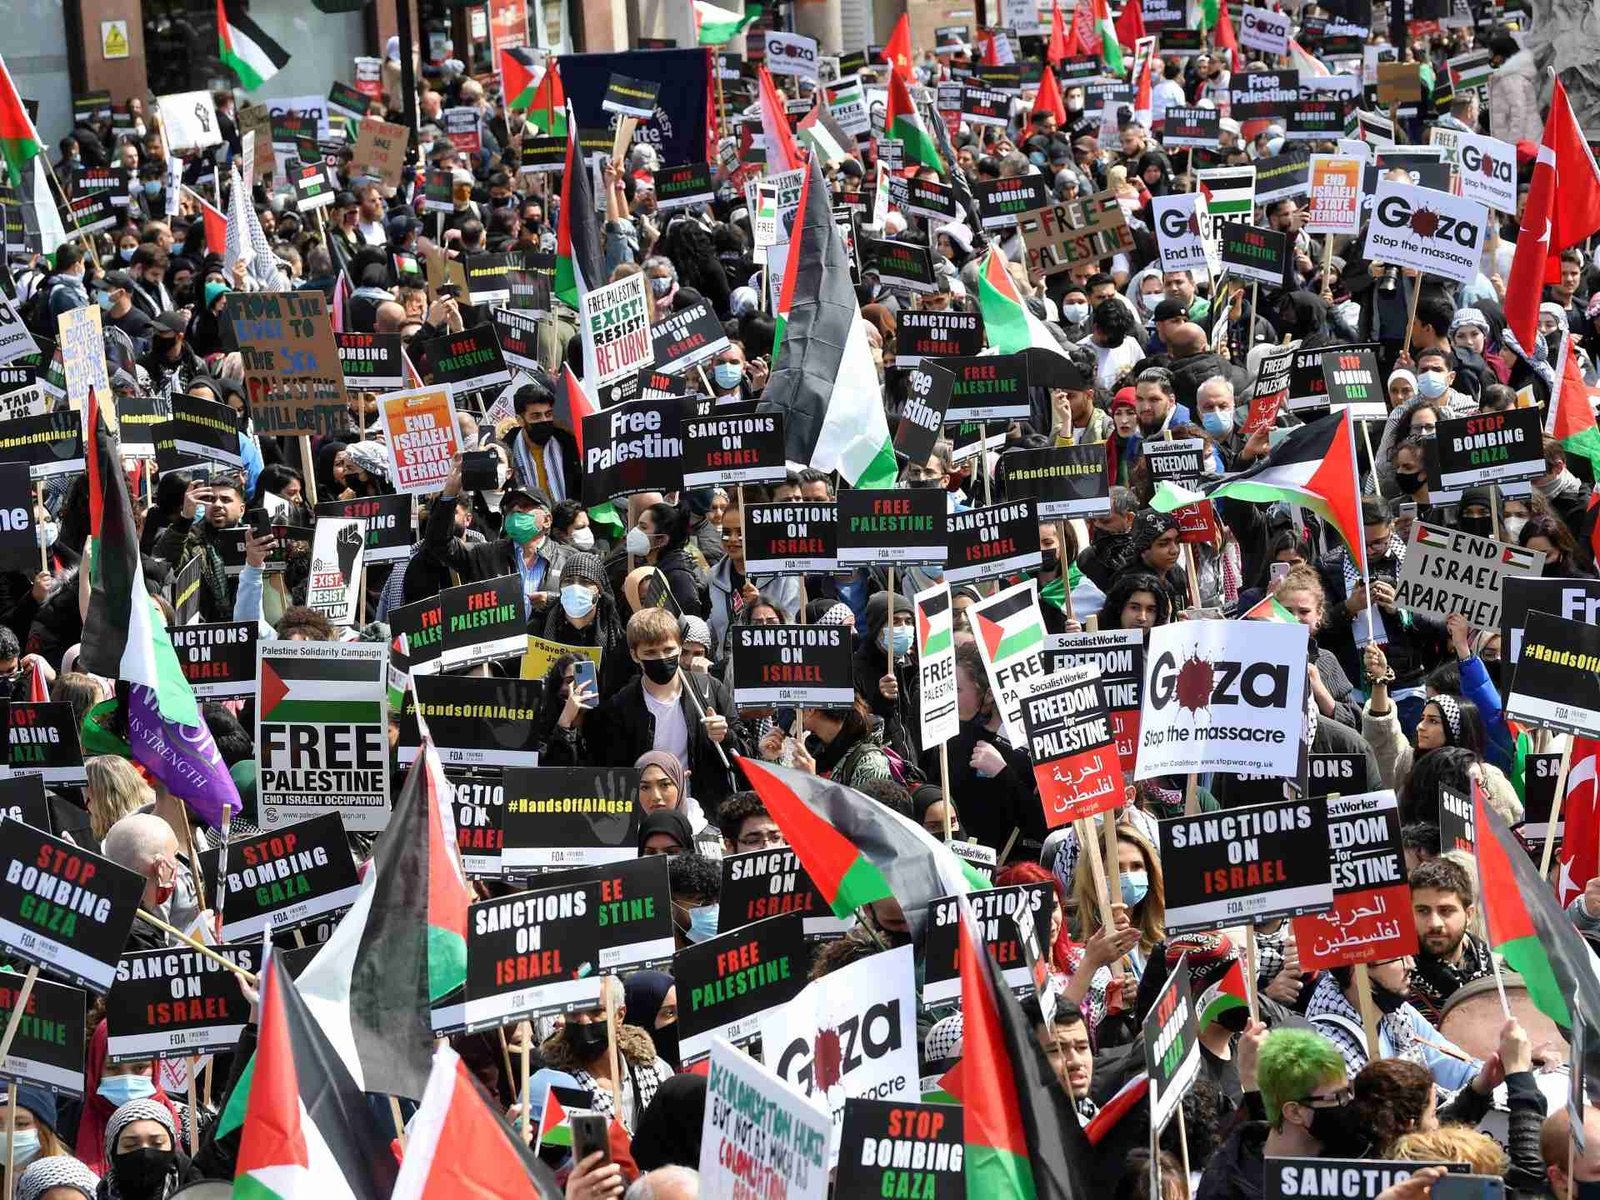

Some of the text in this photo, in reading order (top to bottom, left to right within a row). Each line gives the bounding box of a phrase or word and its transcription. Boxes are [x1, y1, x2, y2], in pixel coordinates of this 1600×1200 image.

[1087, 83, 1134, 94] SANCTIONS
[1248, 74, 1280, 88] Free
[1232, 88, 1298, 104] Palestine
[831, 103, 863, 117] FREE
[1168, 108, 1216, 120] SANCTIONS
[1185, 118, 1197, 127] ON
[1435, 132, 1452, 148] FREE
[79, 177, 120, 188] BOMBING
[996, 177, 1022, 190] STOP
[1323, 173, 1347, 186] END
[988, 187, 1035, 203] BOMBING
[1313, 186, 1356, 198] ISRAELI
[757, 221, 774, 234] FREE
[1040, 200, 1097, 237] FREE
[1312, 211, 1354, 223] TERROR
[1027, 225, 1134, 271] PALESTINE
[1164, 248, 1188, 261] End
[1230, 240, 1277, 262] PALESTINE
[1373, 234, 1399, 248] Stop
[1401, 239, 1419, 253] the
[1421, 245, 1473, 268] massacre
[588, 286, 642, 312] FREE PALESTINE
[497, 310, 536, 334] SANCTIONS
[591, 302, 644, 331] EXIST!
[902, 314, 977, 330] SANCTIONS
[341, 335, 373, 347] STOP
[511, 328, 522, 341] ON
[594, 318, 647, 346] RESIST!
[673, 329, 689, 341] ON
[930, 327, 948, 341] ON
[338, 347, 388, 361] OMBING
[451, 336, 477, 356] FREE
[597, 330, 650, 376] RETURN!
[666, 332, 706, 358] ISRAEL
[916, 340, 961, 354] ISRAEL
[343, 360, 374, 373] GAZA
[438, 346, 495, 373] PALESTINE
[1339, 355, 1361, 370] STOP
[650, 375, 672, 390] STOP
[964, 365, 996, 379] FREE
[1345, 385, 1368, 399] GAZA
[404, 413, 435, 430] END
[610, 408, 661, 438] Free
[687, 417, 775, 439] SANCTIONS
[1466, 416, 1505, 432] STOP
[395, 426, 451, 448] ISRAELI
[721, 435, 742, 450] ON
[1452, 430, 1525, 453] BOMBING
[404, 445, 451, 465] STATE
[706, 450, 760, 467] ISRAEL
[1151, 454, 1199, 473] FREEDOM
[1470, 450, 1510, 466] GAZA
[1008, 462, 1103, 481] #HandsOffAlAqsa
[344, 502, 380, 518] STOP
[752, 507, 838, 525] SANCTIONS
[873, 498, 912, 515] FREE
[850, 515, 934, 533] PALESTINE
[946, 504, 1029, 533] SANCTIONS
[787, 523, 808, 538] ON
[980, 525, 1000, 543] ON
[771, 539, 826, 555] ISRAEL
[966, 541, 1017, 561] ISRAEL
[1452, 534, 1498, 560] END
[467, 590, 498, 611] FREE
[1394, 579, 1501, 630] APARTHEI
[450, 603, 517, 633] PALESTINE
[741, 629, 841, 647] SANCTIONS
[1058, 634, 1128, 648] Socialist Worker
[188, 646, 212, 663] ON
[261, 646, 382, 659] Palestine Solidarity Campaign
[780, 647, 803, 665] ON
[761, 665, 823, 682] ISRAEL
[922, 656, 953, 688] FREE
[1029, 670, 1089, 694] Socialist Worker
[406, 702, 535, 722] #HandsOffAlAqsa
[1028, 684, 1099, 725] FREEDOM
[1063, 715, 1077, 727] for
[260, 723, 384, 770] FREE
[1032, 717, 1110, 760] PALESTINE
[1144, 725, 1286, 747] Stop the massacre
[141, 729, 208, 789] STRENGTH
[261, 770, 384, 793] PALESTINE
[263, 793, 384, 807] END ISRAELI OCCUPATION
[1053, 776, 1115, 813] لفلسطين
[1342, 799, 1379, 811] Worker
[459, 805, 487, 827] ON
[508, 798, 633, 814] #HandsOffAlAqsa
[1171, 803, 1313, 850] SANCTIONS
[1328, 815, 1389, 849] EDOM
[243, 833, 298, 866] STOP
[1227, 837, 1260, 865] ON
[1335, 849, 1352, 863] for
[37, 842, 96, 886] STOP
[227, 846, 329, 894] BOMBING
[1330, 854, 1401, 889] ESTINE
[769, 871, 796, 894] ON
[1204, 859, 1288, 894] ISRAEL
[5, 859, 112, 924] BOMBING
[255, 873, 312, 907] GAZA
[18, 895, 78, 938] GAZA
[476, 890, 588, 935] SANCTIONS
[599, 896, 655, 927] STINE
[748, 891, 814, 921] ISRAEL
[515, 926, 541, 954] ON
[1313, 919, 1401, 956] لفلسطين
[496, 949, 563, 986] ISRAEL
[716, 941, 760, 977] FREE
[170, 975, 202, 1000] ON
[691, 955, 793, 1012] PALESTINE
[147, 998, 229, 1026] ISRAEL
[1157, 980, 1179, 1031] STOP
[1164, 1034, 1186, 1079] GAZA
[712, 1096, 731, 1135] BUT
[734, 1114, 753, 1152] NOT
[755, 1129, 766, 1161] AS
[888, 1108, 944, 1139] STOP
[860, 1137, 963, 1173] BOMBING
[881, 1170, 936, 1200] GAZA
